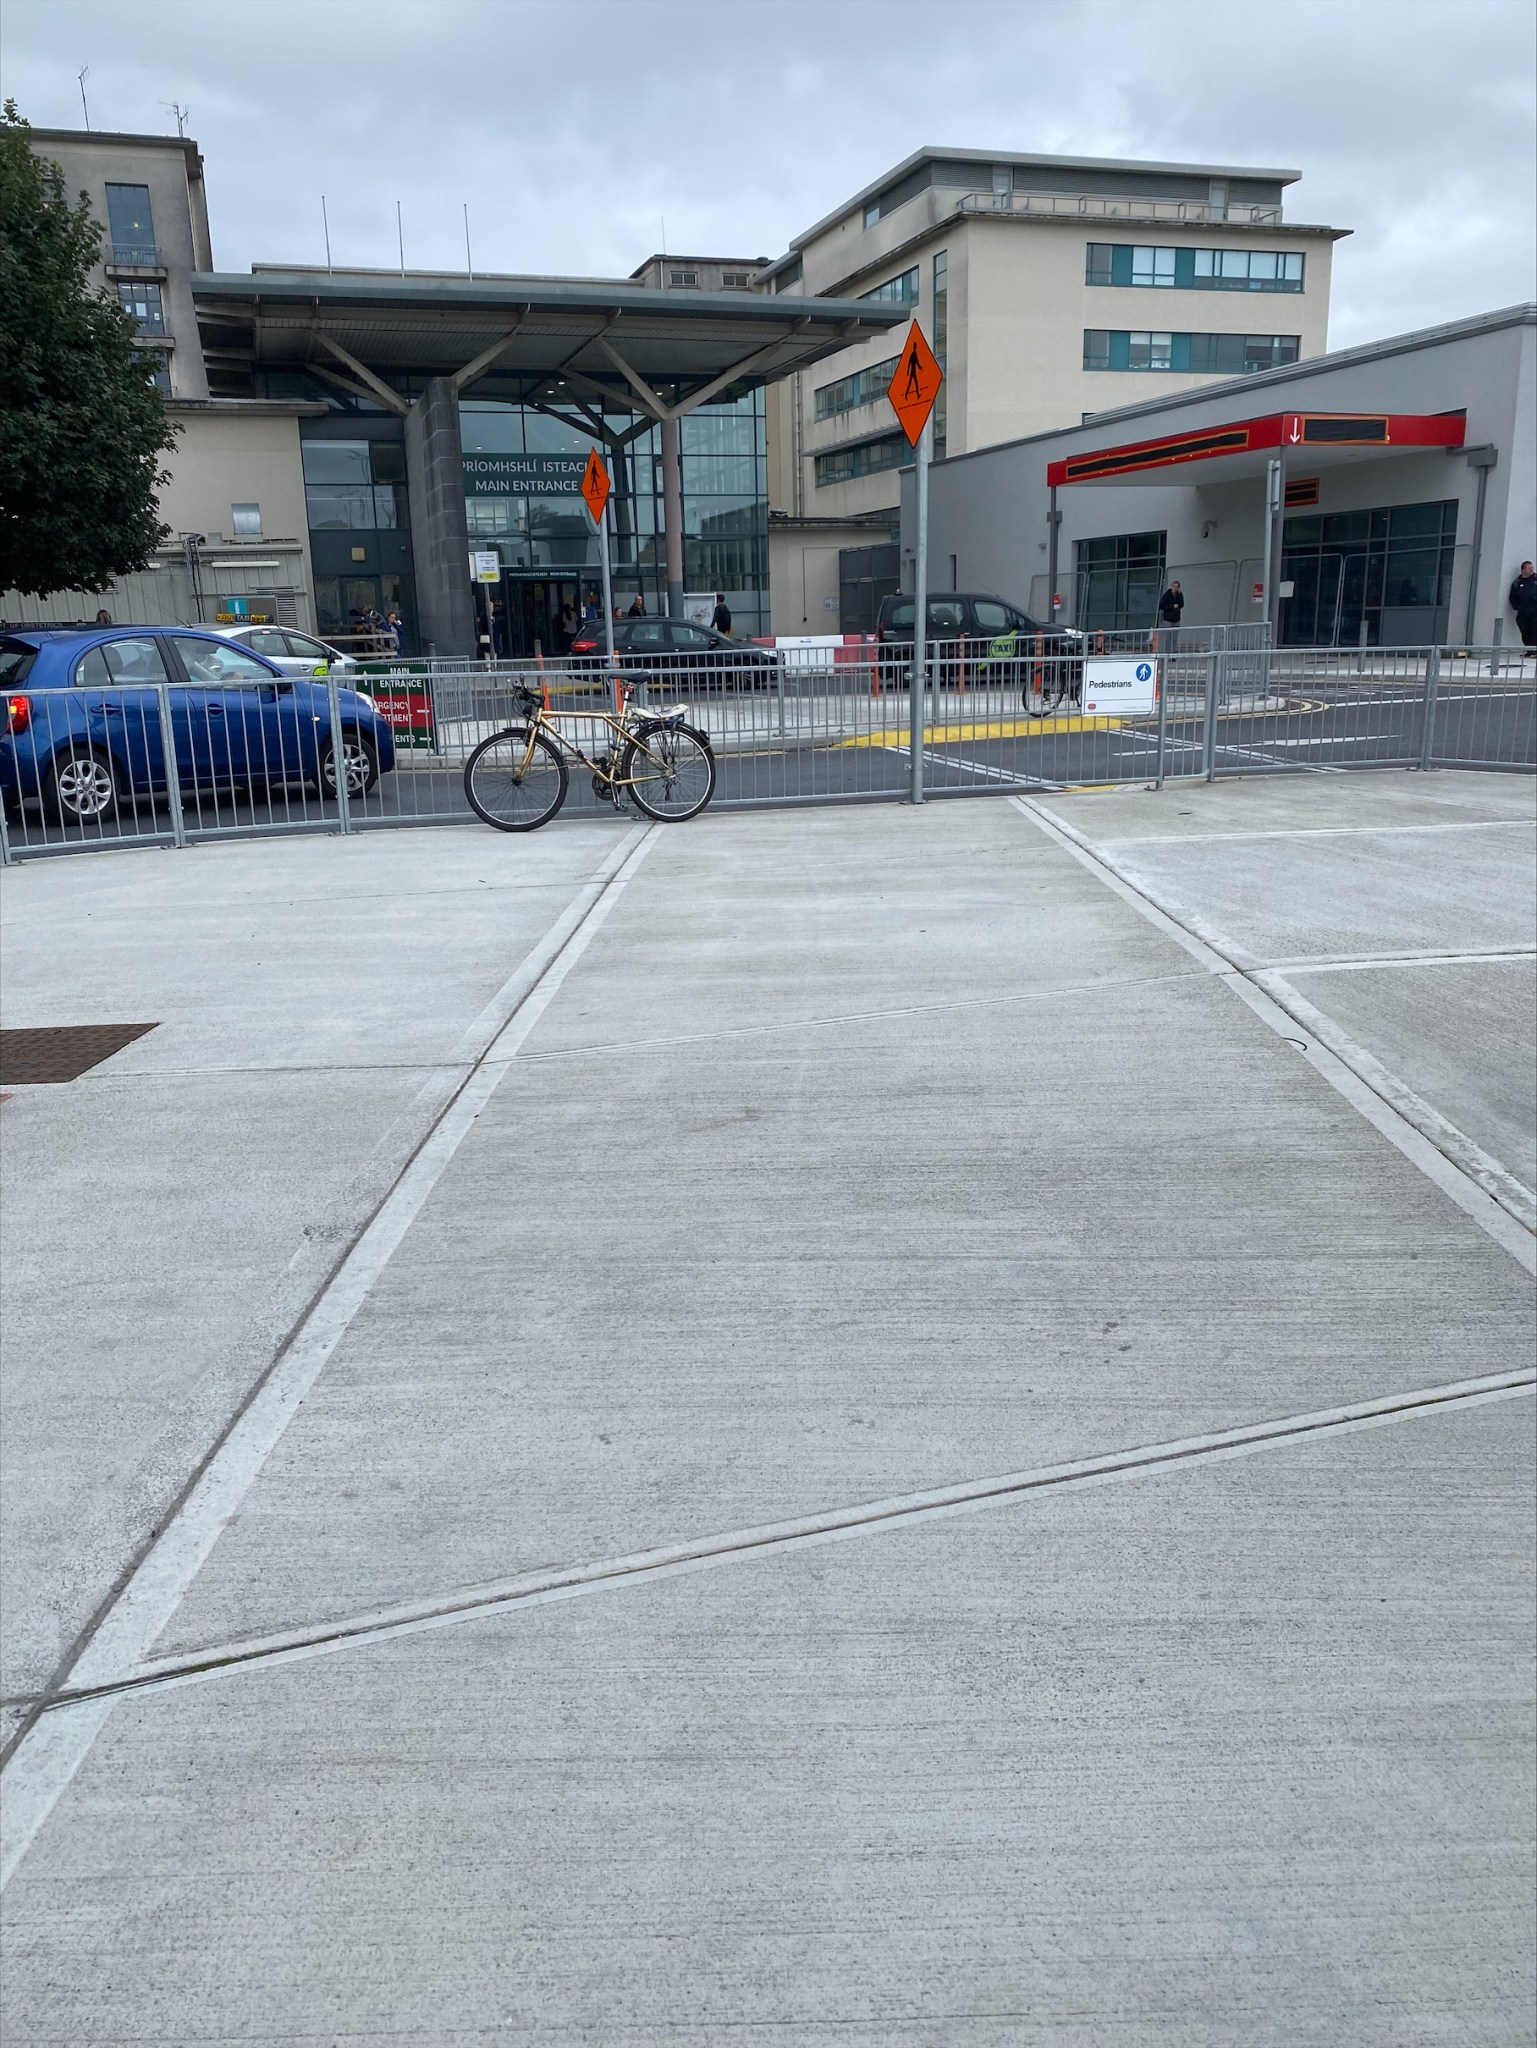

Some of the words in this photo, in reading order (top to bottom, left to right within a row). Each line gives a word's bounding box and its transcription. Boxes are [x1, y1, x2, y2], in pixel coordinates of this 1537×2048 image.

[543, 461, 587, 473] ISTEAC
[475, 480, 510, 492] MAIN
[512, 480, 579, 492] ENTRANCE
[380, 680, 422, 688] ENTRANCE
[1088, 680, 1133, 689] Pedestrians
[377, 701, 410, 710] RGENCY
[382, 713, 413, 722] RTMENT
[395, 734, 416, 743] ENTS
